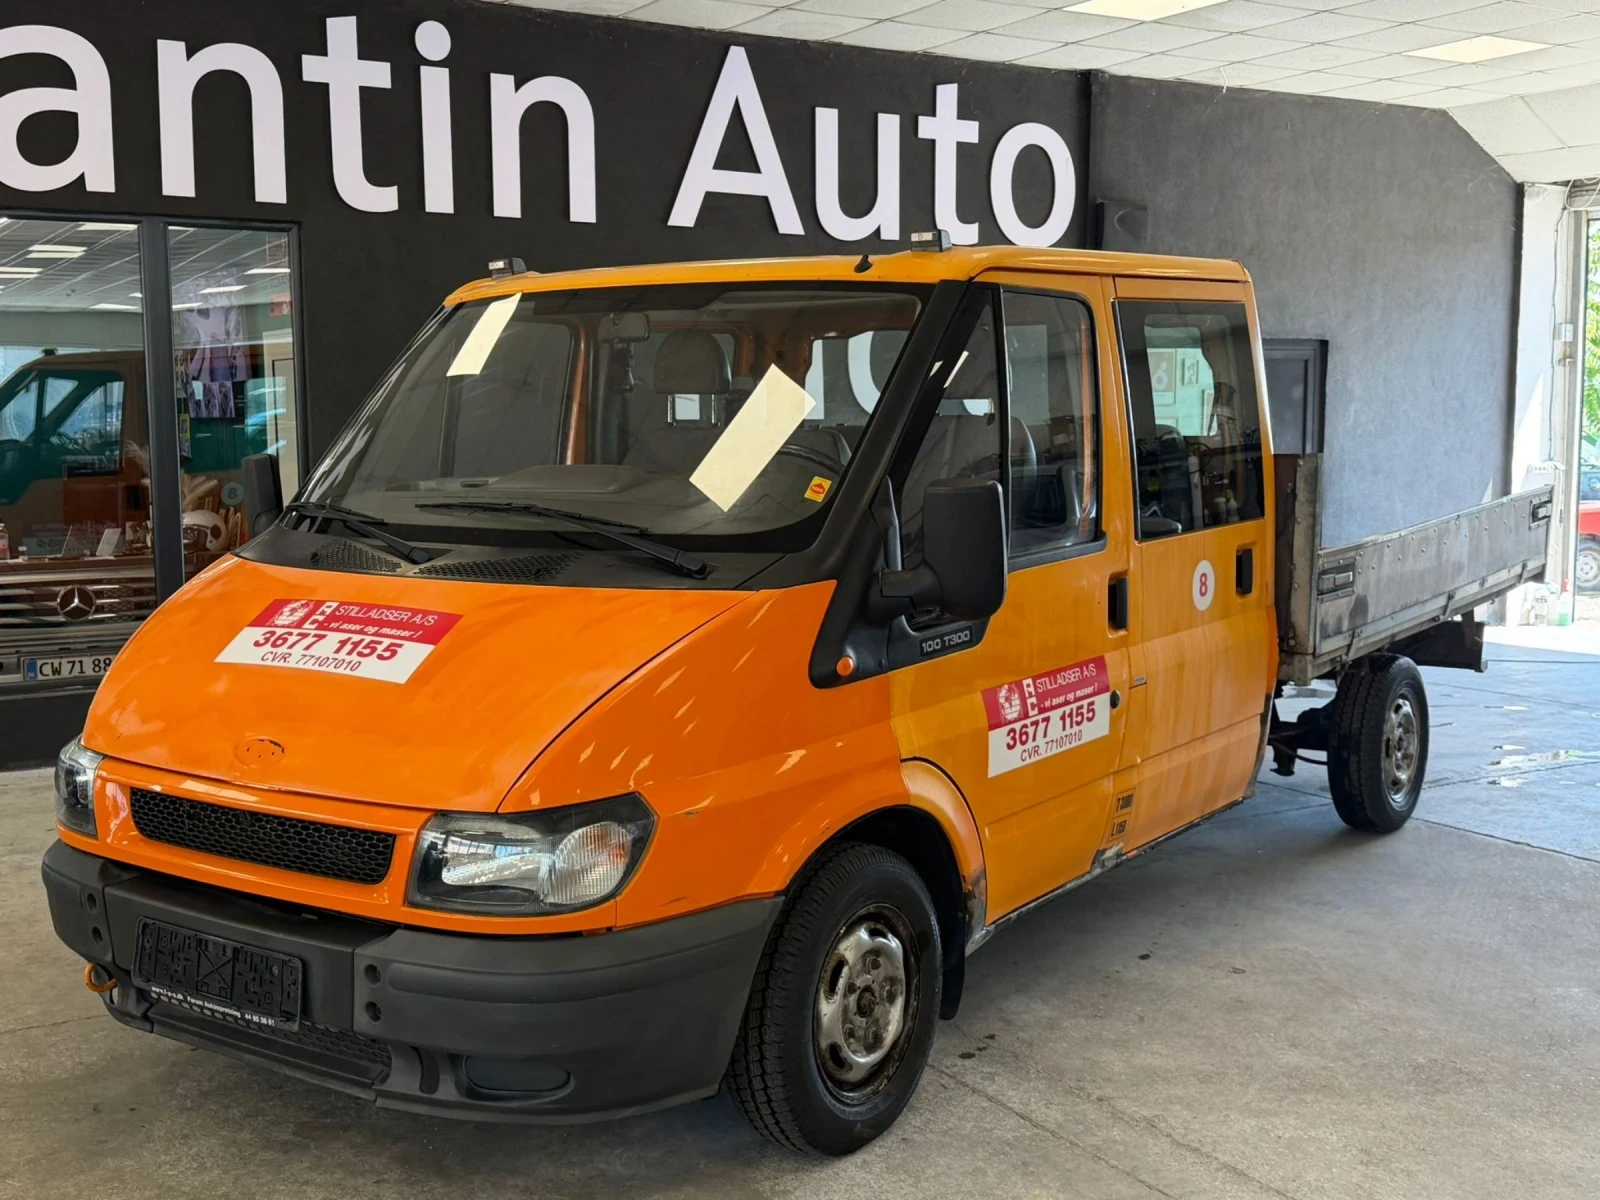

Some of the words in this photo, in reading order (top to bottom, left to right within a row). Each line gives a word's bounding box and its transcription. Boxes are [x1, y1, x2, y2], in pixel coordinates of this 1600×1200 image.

[0, 15, 597, 223] antin
[667, 45, 1076, 247] Auto
[1199, 572, 1208, 597] 8
[335, 605, 411, 622] STILLADSER
[409, 613, 438, 626] A/S
[341, 623, 363, 632] aser
[363, 625, 377, 634] og
[253, 630, 328, 651] 3677
[333, 636, 404, 661] 1155
[922, 638, 941, 653] 100
[943, 630, 970, 646] T300
[39, 662, 62, 677] CW
[67, 660, 85, 675] 71
[260, 651, 290, 664] CVR.
[294, 654, 362, 672] 77107010
[1036, 668, 1082, 692] STILLADSER
[1082, 663, 1096, 679] A/S
[1066, 692, 1075, 702] og
[1006, 716, 1051, 751] 3677
[1059, 701, 1096, 732] 1155
[1020, 746, 1042, 762] CVR.
[1045, 730, 1082, 754] 77107010
